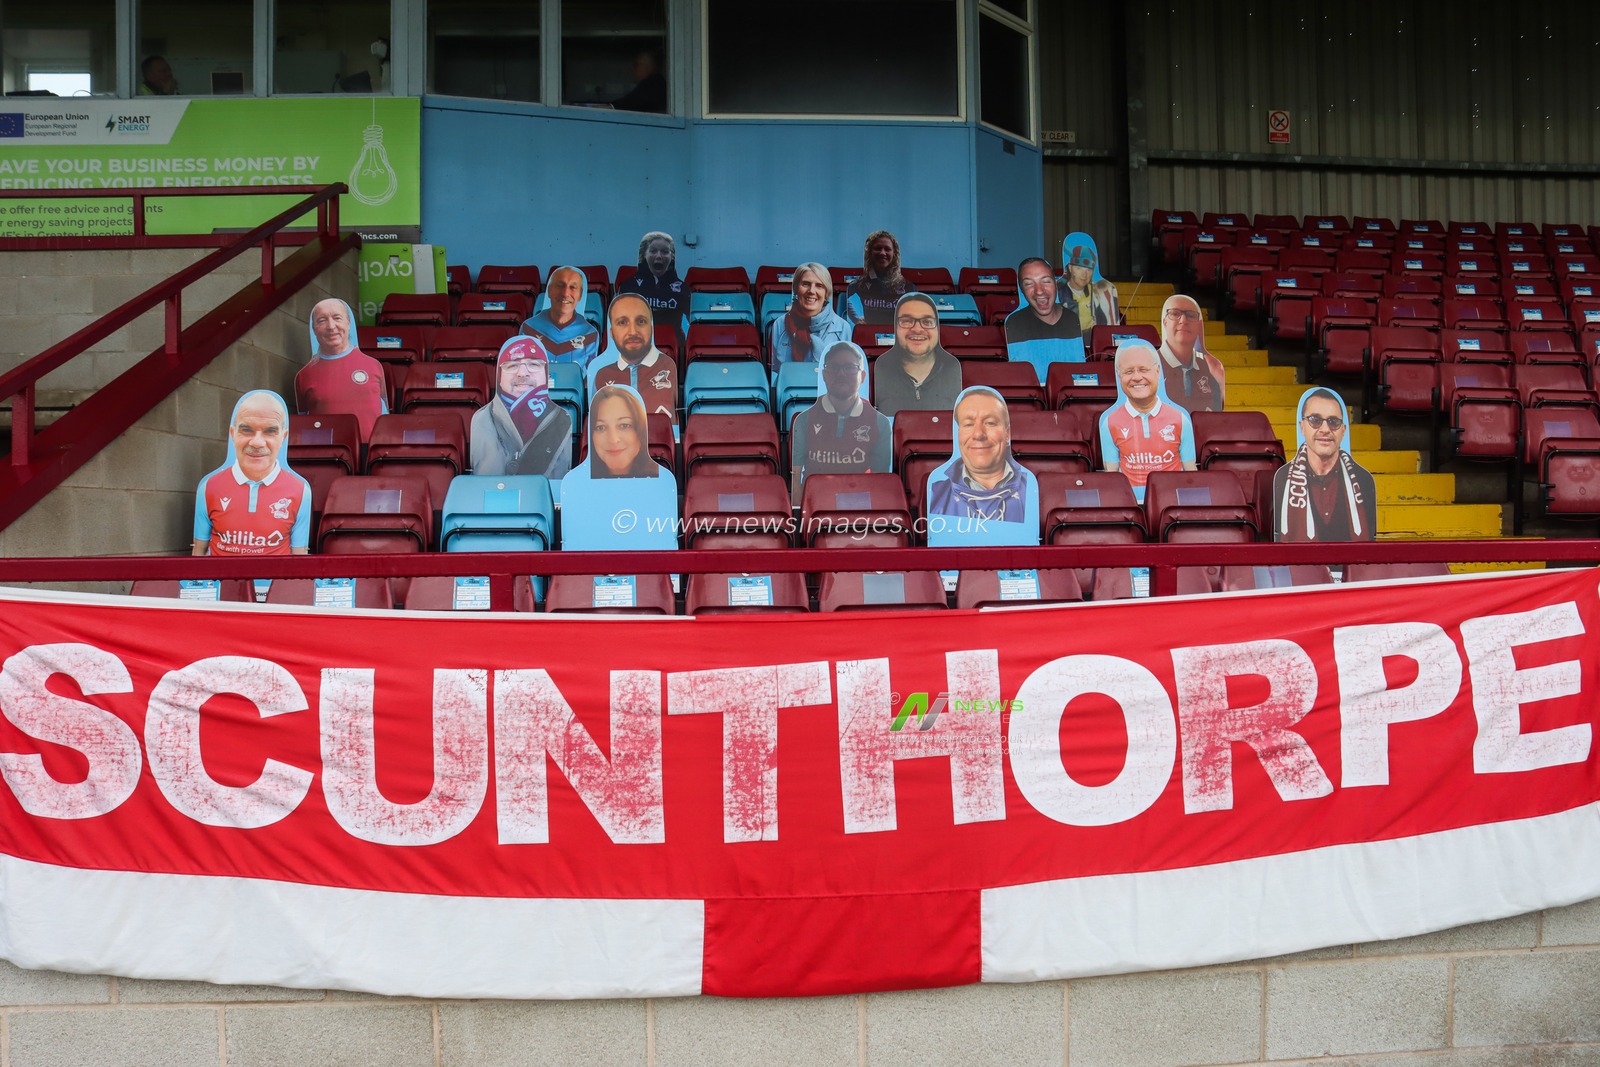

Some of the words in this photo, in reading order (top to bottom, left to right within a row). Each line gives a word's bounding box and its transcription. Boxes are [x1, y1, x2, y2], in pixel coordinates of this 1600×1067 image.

[25, 113, 63, 122] European
[1049, 132, 1069, 140] CLEAR
[45, 159, 102, 173] YOUR
[109, 158, 208, 173] BUSINESS
[214, 157, 287, 172] MONEY
[293, 156, 320, 171] BY
[100, 177, 156, 189] YOUR
[163, 176, 243, 188] ENERGY
[249, 175, 313, 186] COSTS
[10, 205, 35, 214] offer
[38, 205, 61, 214] free
[64, 205, 100, 214] advice
[103, 205, 124, 213] and
[127, 205, 163, 215] gnts
[7, 220, 45, 229] energy
[49, 218, 84, 229] saving
[88, 217, 132, 228] projects
[864, 299, 892, 308] utilita
[808, 450, 852, 464] utilita
[1124, 452, 1162, 464] utilita
[218, 530, 266, 546] utilita
[0, 600, 1592, 848] SCUNTHORPE
